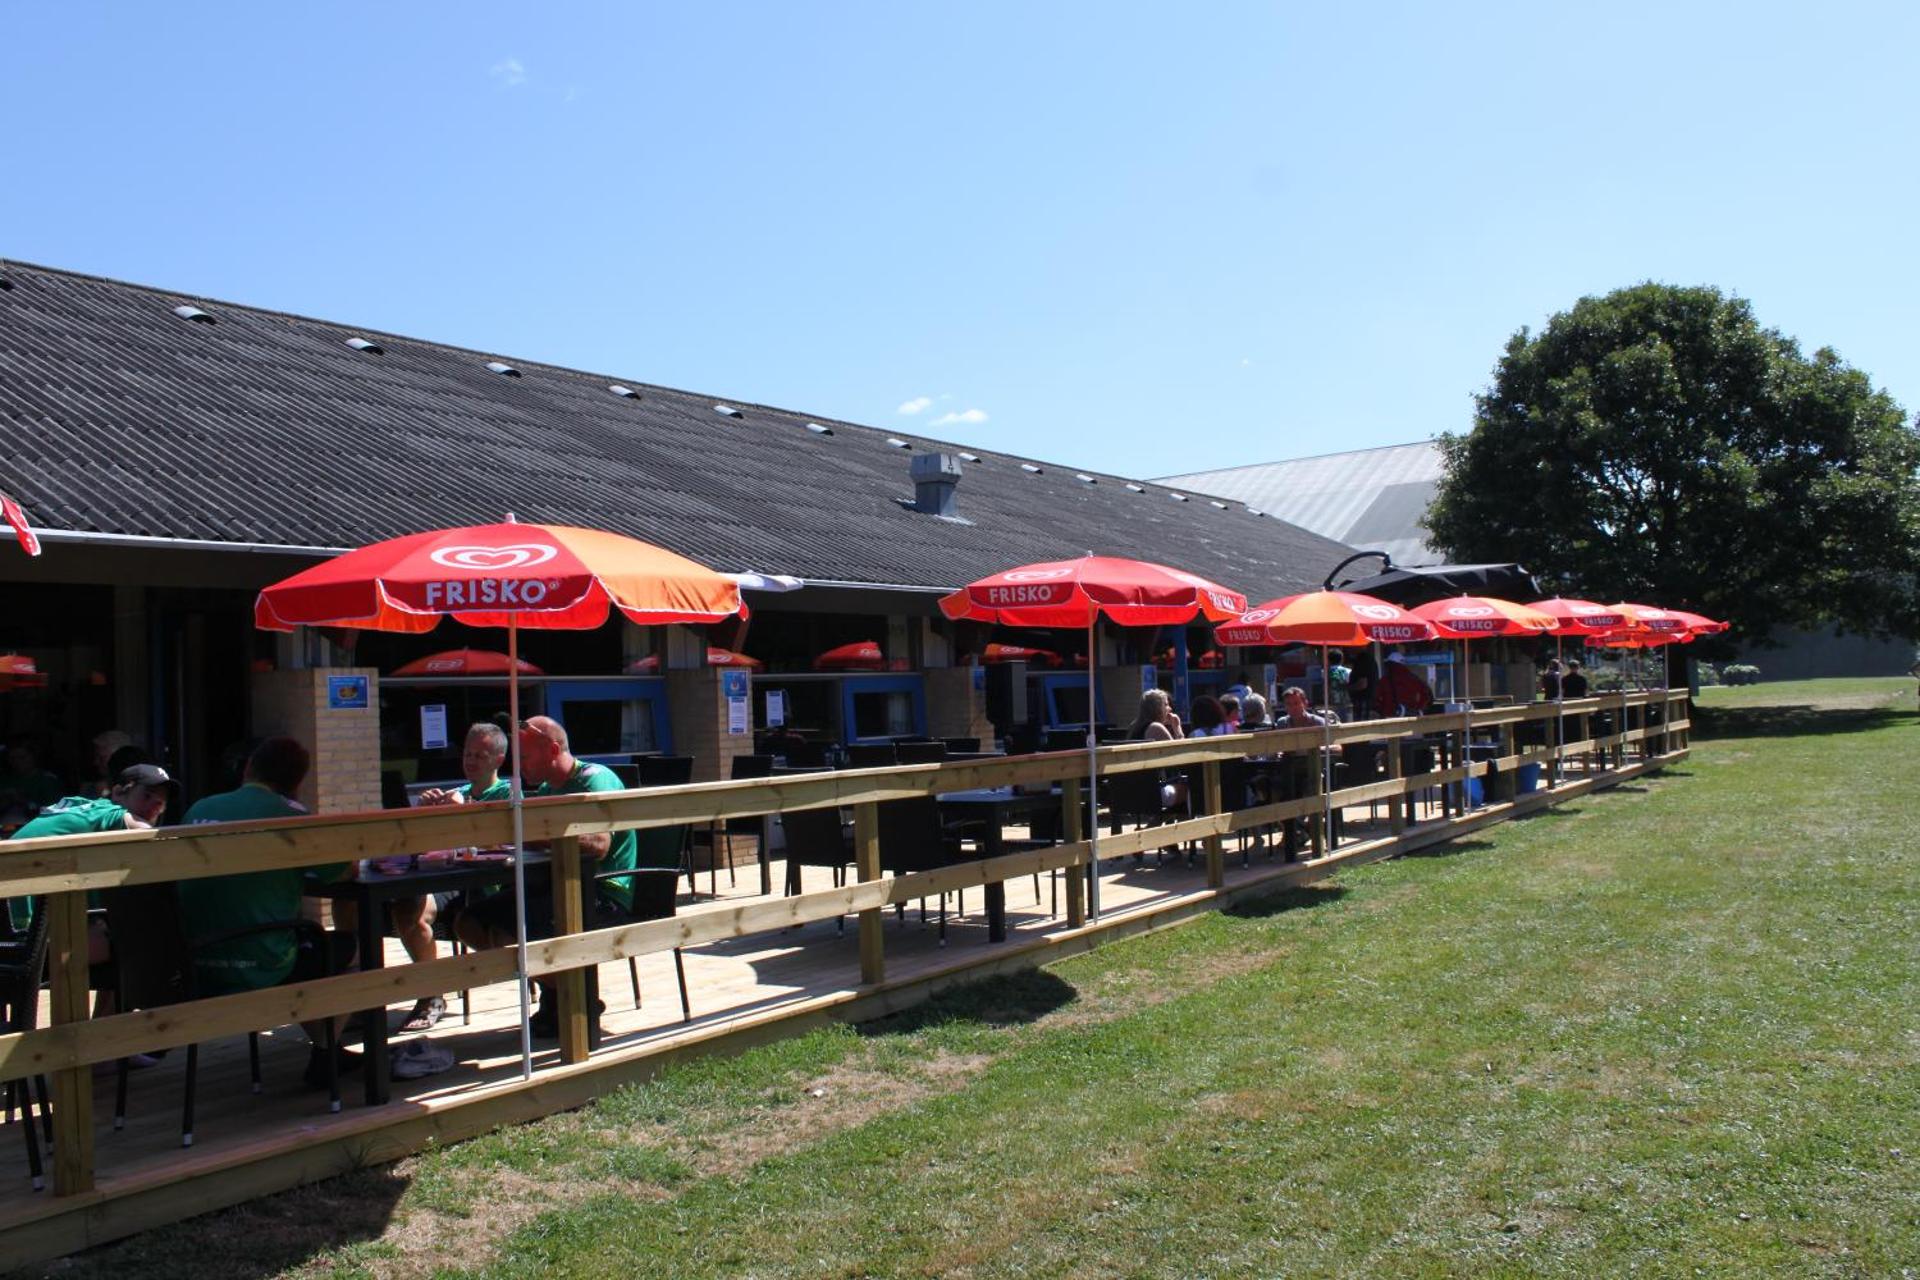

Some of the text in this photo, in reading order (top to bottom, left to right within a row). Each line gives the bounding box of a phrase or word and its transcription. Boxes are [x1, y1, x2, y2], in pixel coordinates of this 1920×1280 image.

[426, 578, 546, 606] FRISKO
[989, 585, 1052, 603] FRISKO
[1452, 620, 1493, 630] FRISKO
[1228, 630, 1261, 641] FRISKO
[1372, 626, 1411, 638] FRISKO
